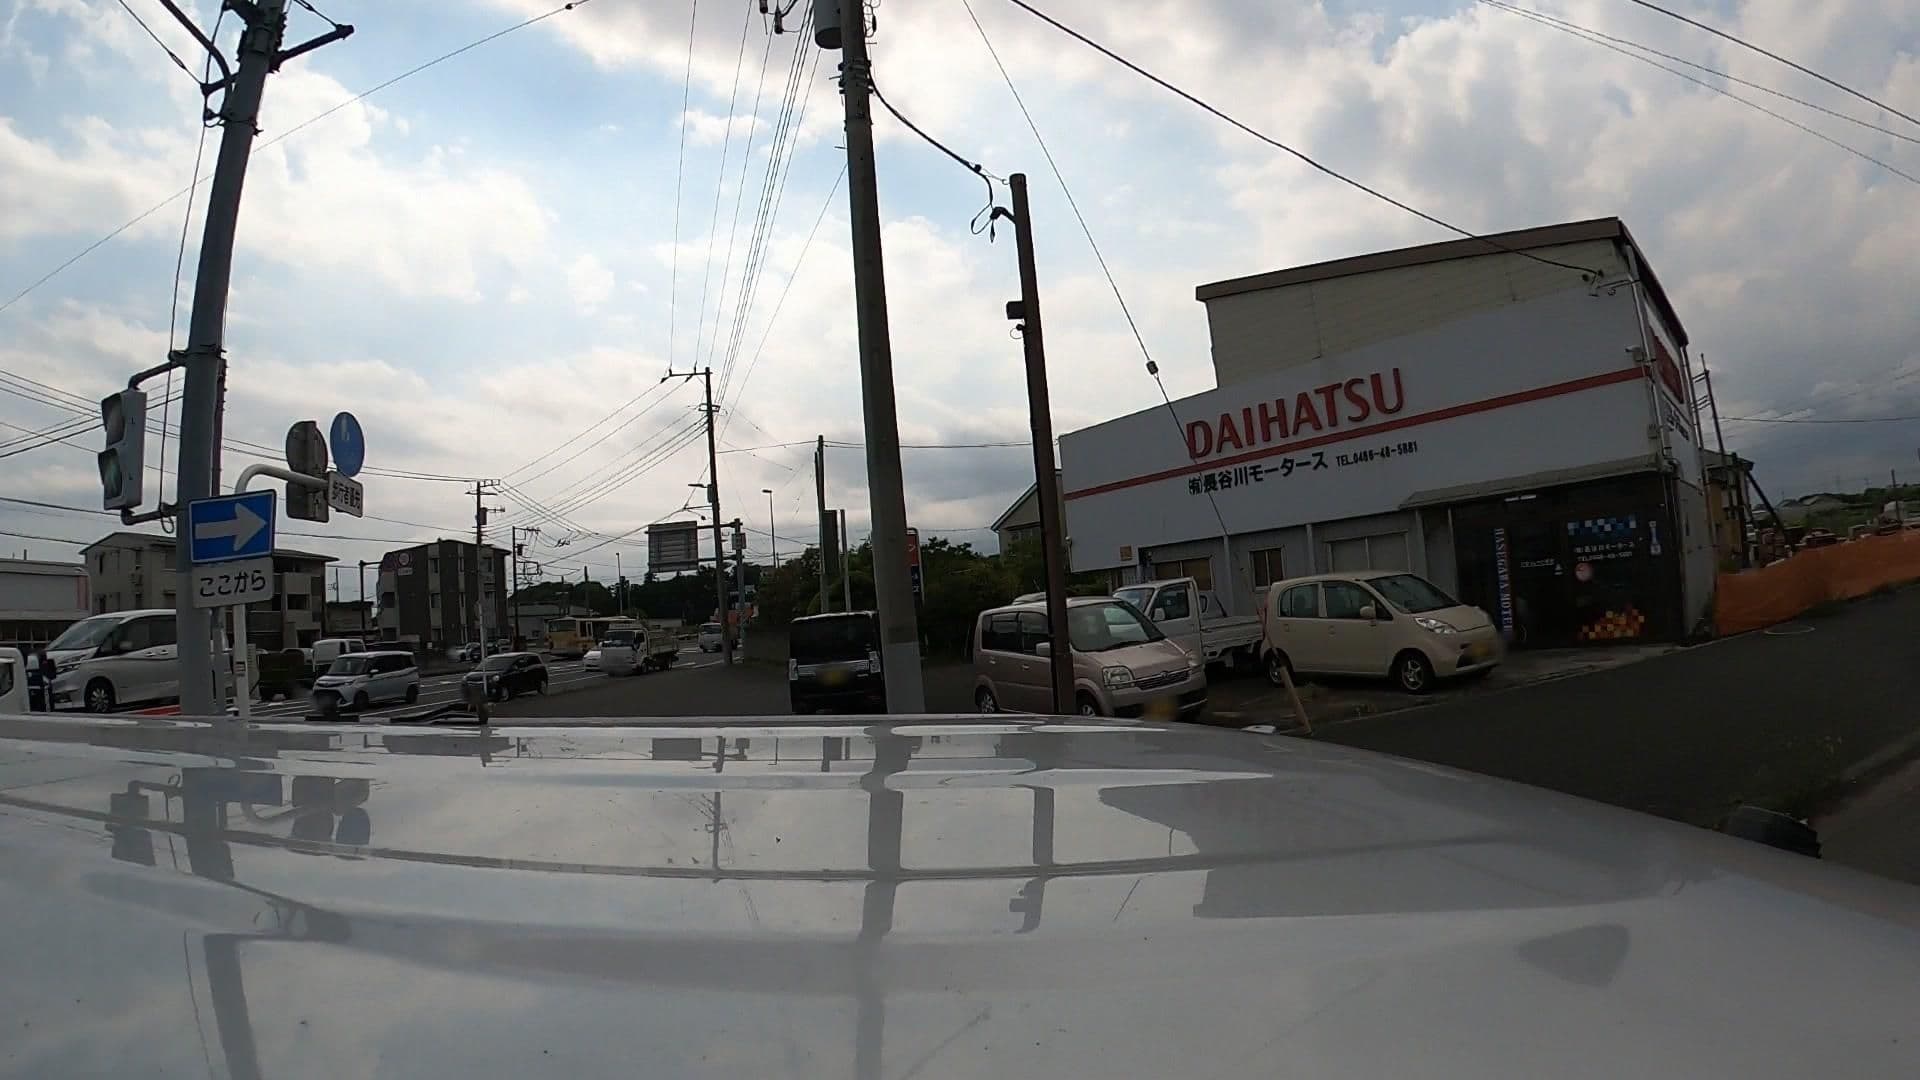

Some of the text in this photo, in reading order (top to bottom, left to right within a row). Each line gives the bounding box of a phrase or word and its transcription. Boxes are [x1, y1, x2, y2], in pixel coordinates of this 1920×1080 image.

[1186, 367, 1406, 460] DAIHATSU
[200, 569, 266, 597] ここから
